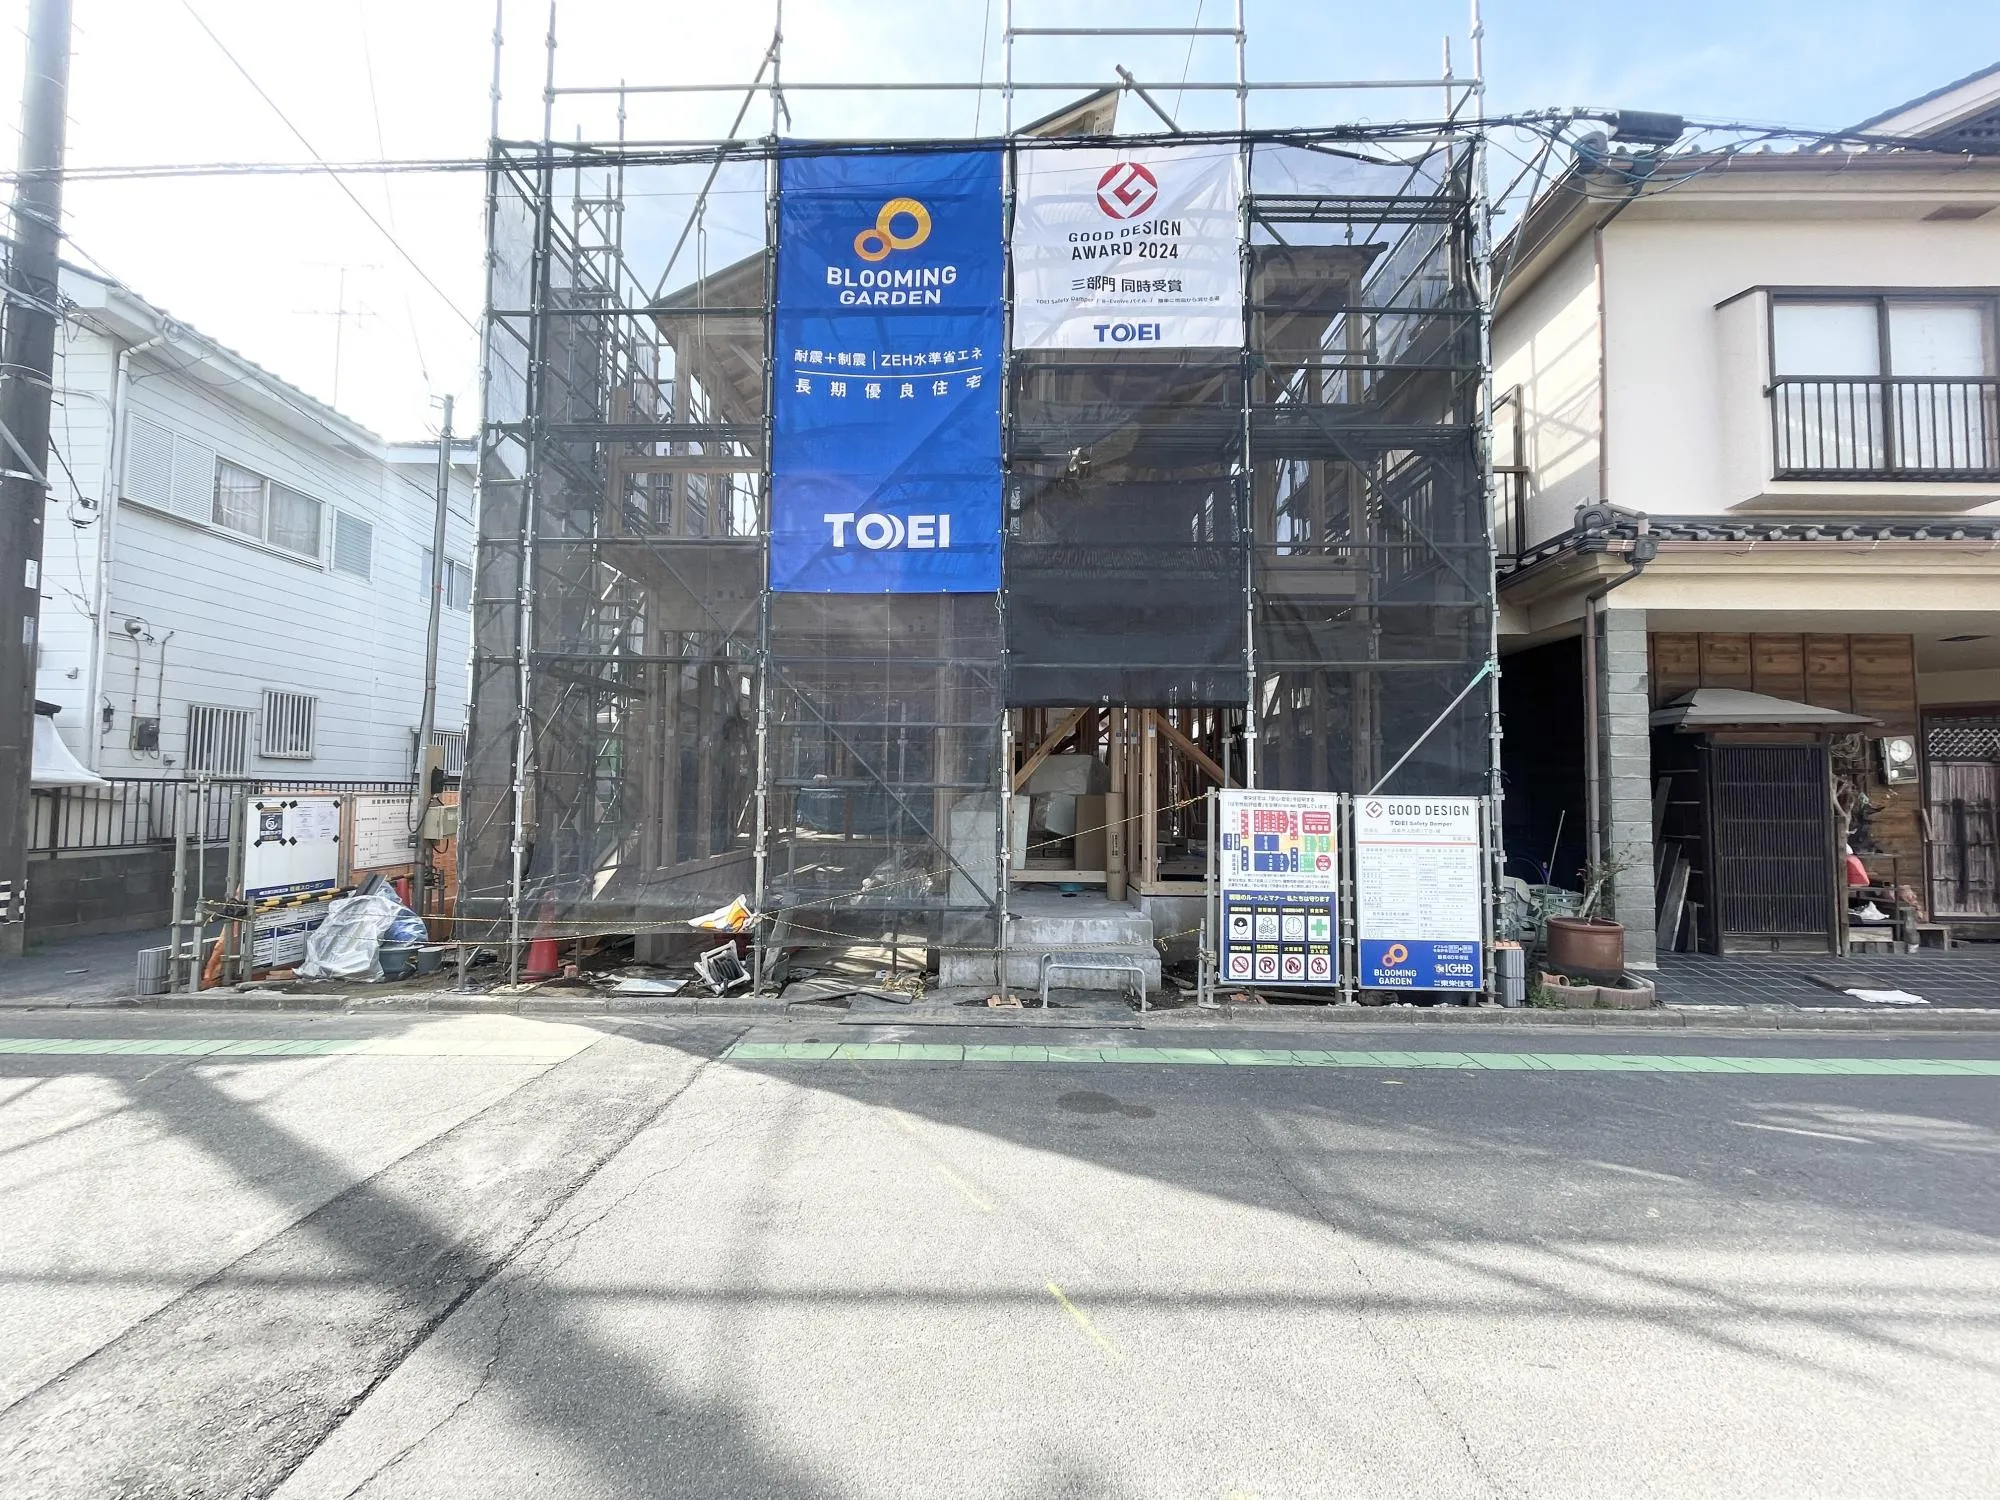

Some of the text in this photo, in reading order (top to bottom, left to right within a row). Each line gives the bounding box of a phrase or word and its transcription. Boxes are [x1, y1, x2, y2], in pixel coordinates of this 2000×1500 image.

[1068, 219, 1182, 243] GOOD DESIGN
[1071, 241, 1179, 260] AWARD 2024
[826, 266, 957, 288] BLOOMING
[1071, 276, 1183, 293] 三部門 同時受賞
[839, 289, 941, 305] GARDEN
[795, 374, 982, 399] 長期優良住宅
[1388, 804, 1470, 816] GOOD DESIGN
[1373, 968, 1417, 977] BLOOMING
[1378, 977, 1413, 985] GARDEN
